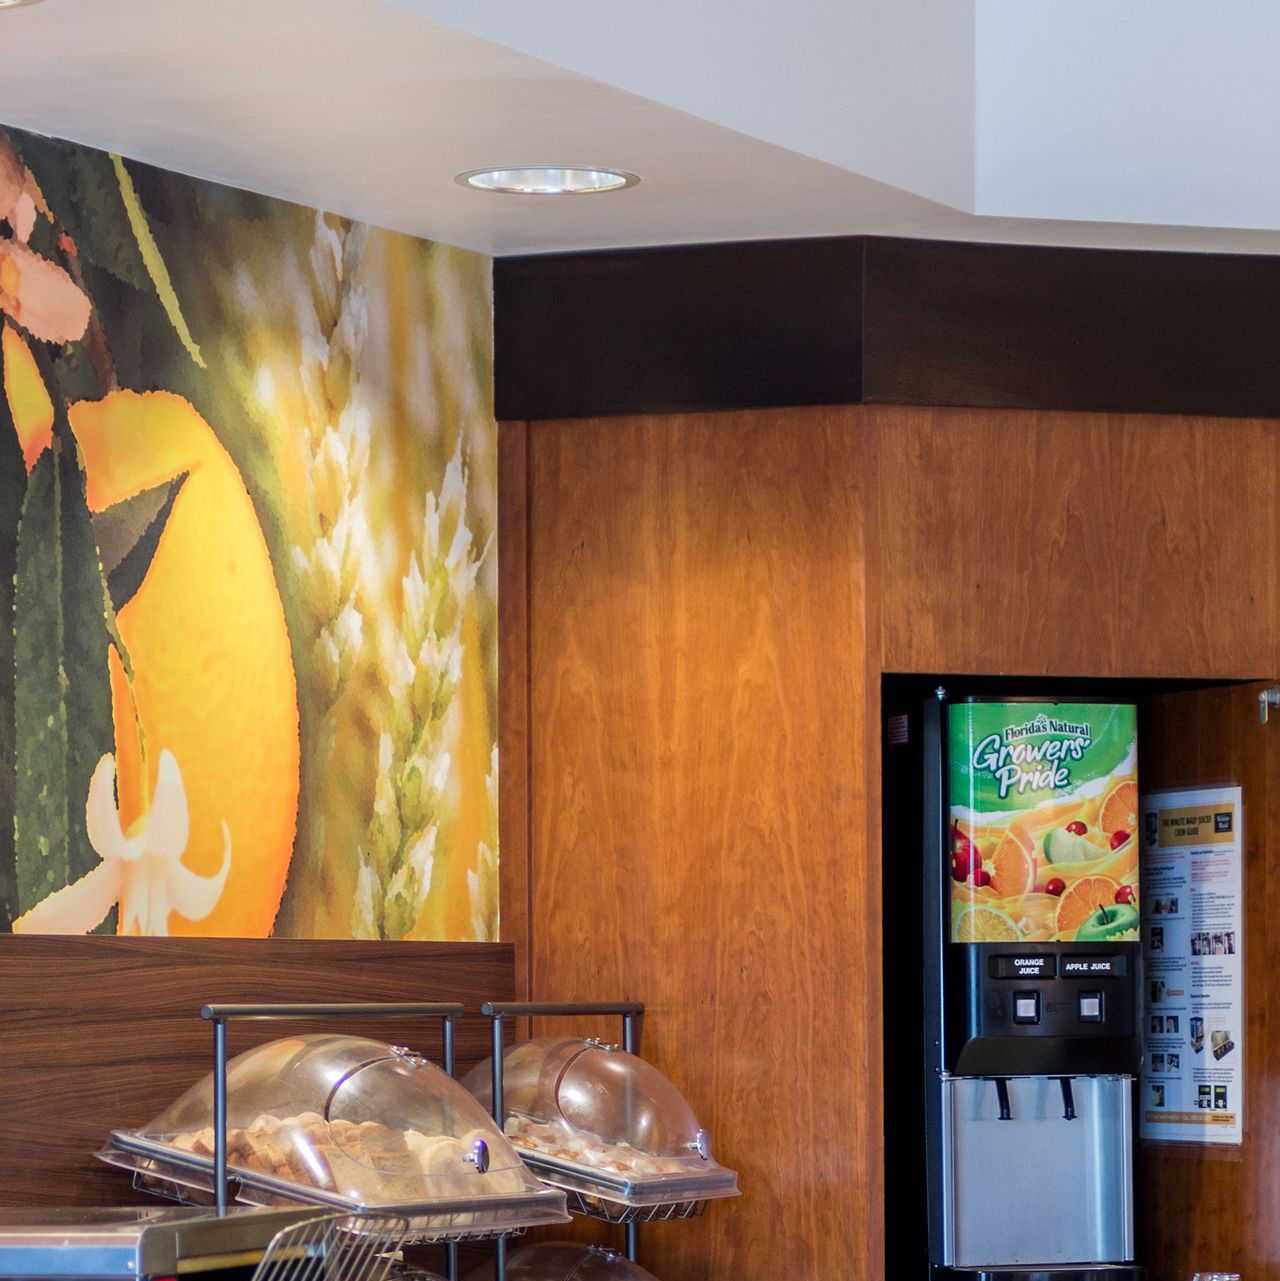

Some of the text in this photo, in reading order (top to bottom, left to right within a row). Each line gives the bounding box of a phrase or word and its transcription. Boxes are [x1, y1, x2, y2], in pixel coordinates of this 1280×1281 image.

[1004, 720, 1090, 741] Florida's Natural
[972, 734, 1091, 772] Growers'
[994, 759, 1070, 799] Pride
[1014, 958, 1045, 967] ORANGE
[1065, 962, 1111, 971] APPLE JUICE
[1018, 967, 1040, 975] JUICE
